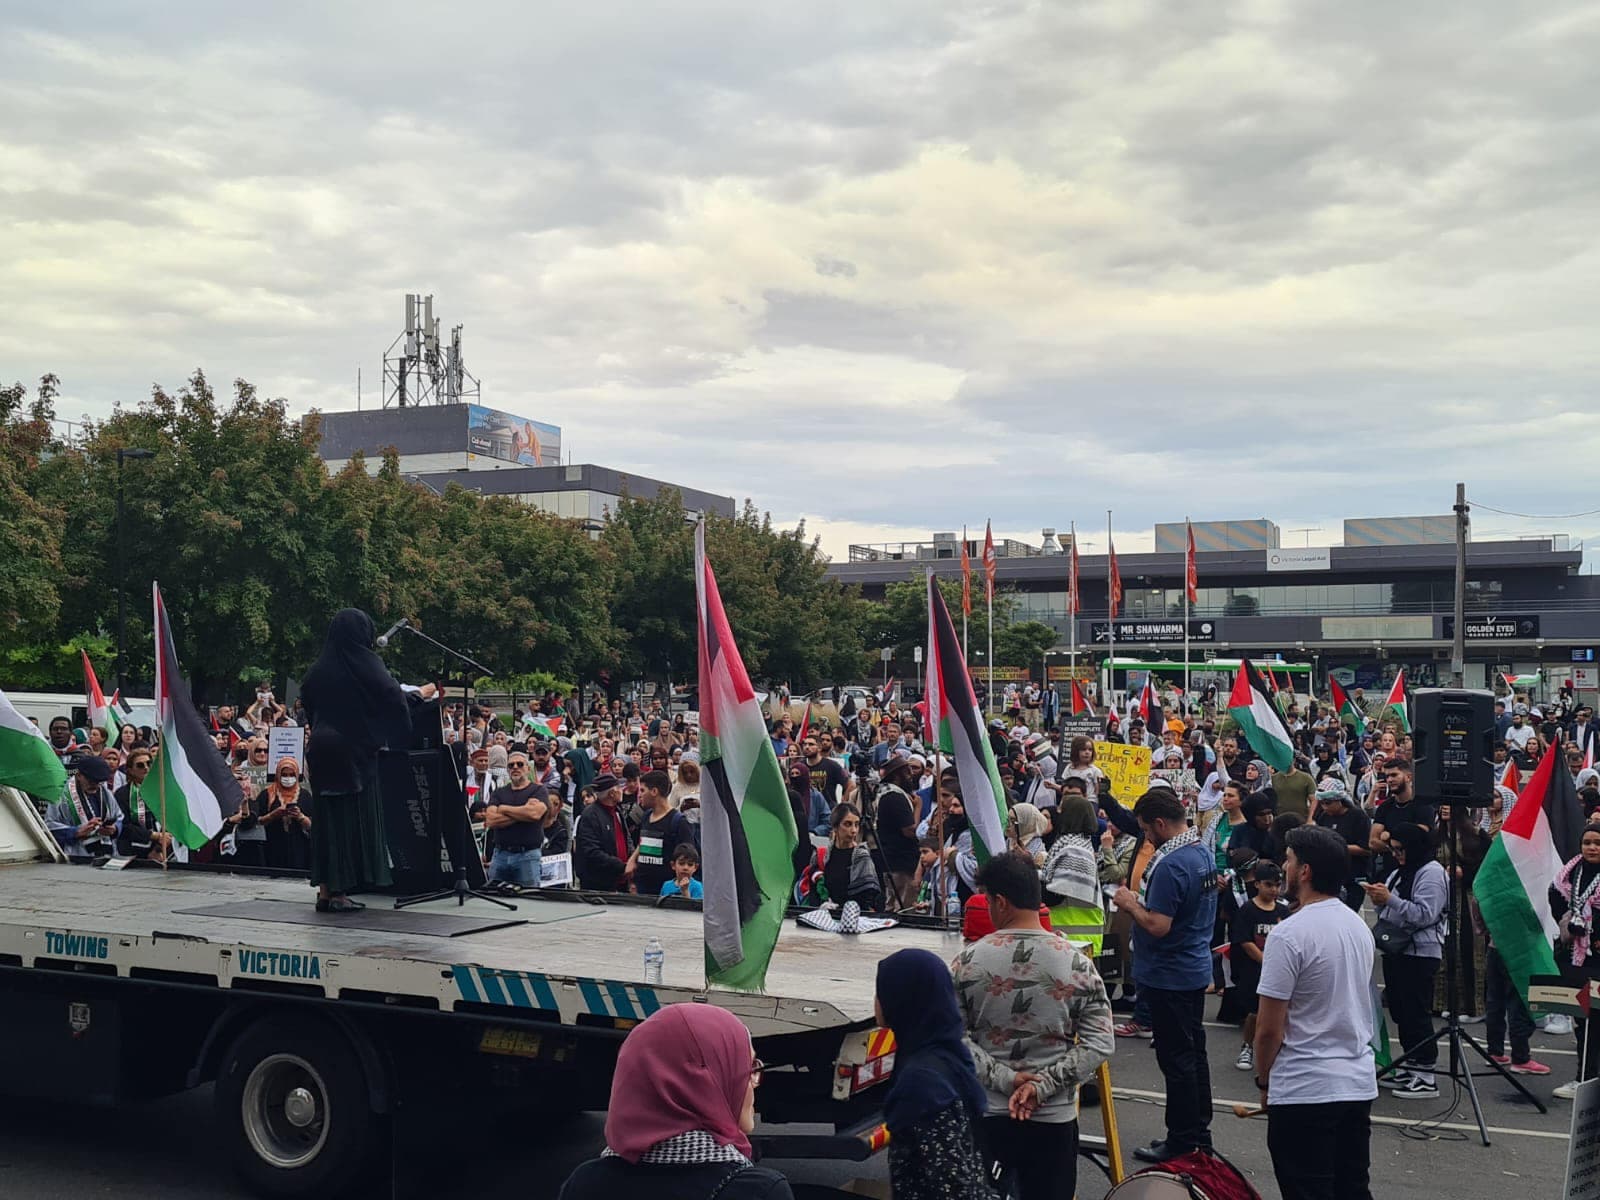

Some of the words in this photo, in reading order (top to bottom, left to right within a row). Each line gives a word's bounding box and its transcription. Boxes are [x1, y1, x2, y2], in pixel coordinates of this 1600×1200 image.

[1121, 624, 1134, 635] MR
[1136, 624, 1184, 635] SHAWARMA
[1467, 625, 1495, 633] GOLDEN
[1496, 625, 1515, 633] EYES
[45, 931, 108, 959] TOWING
[238, 949, 321, 980] VICTORIA
